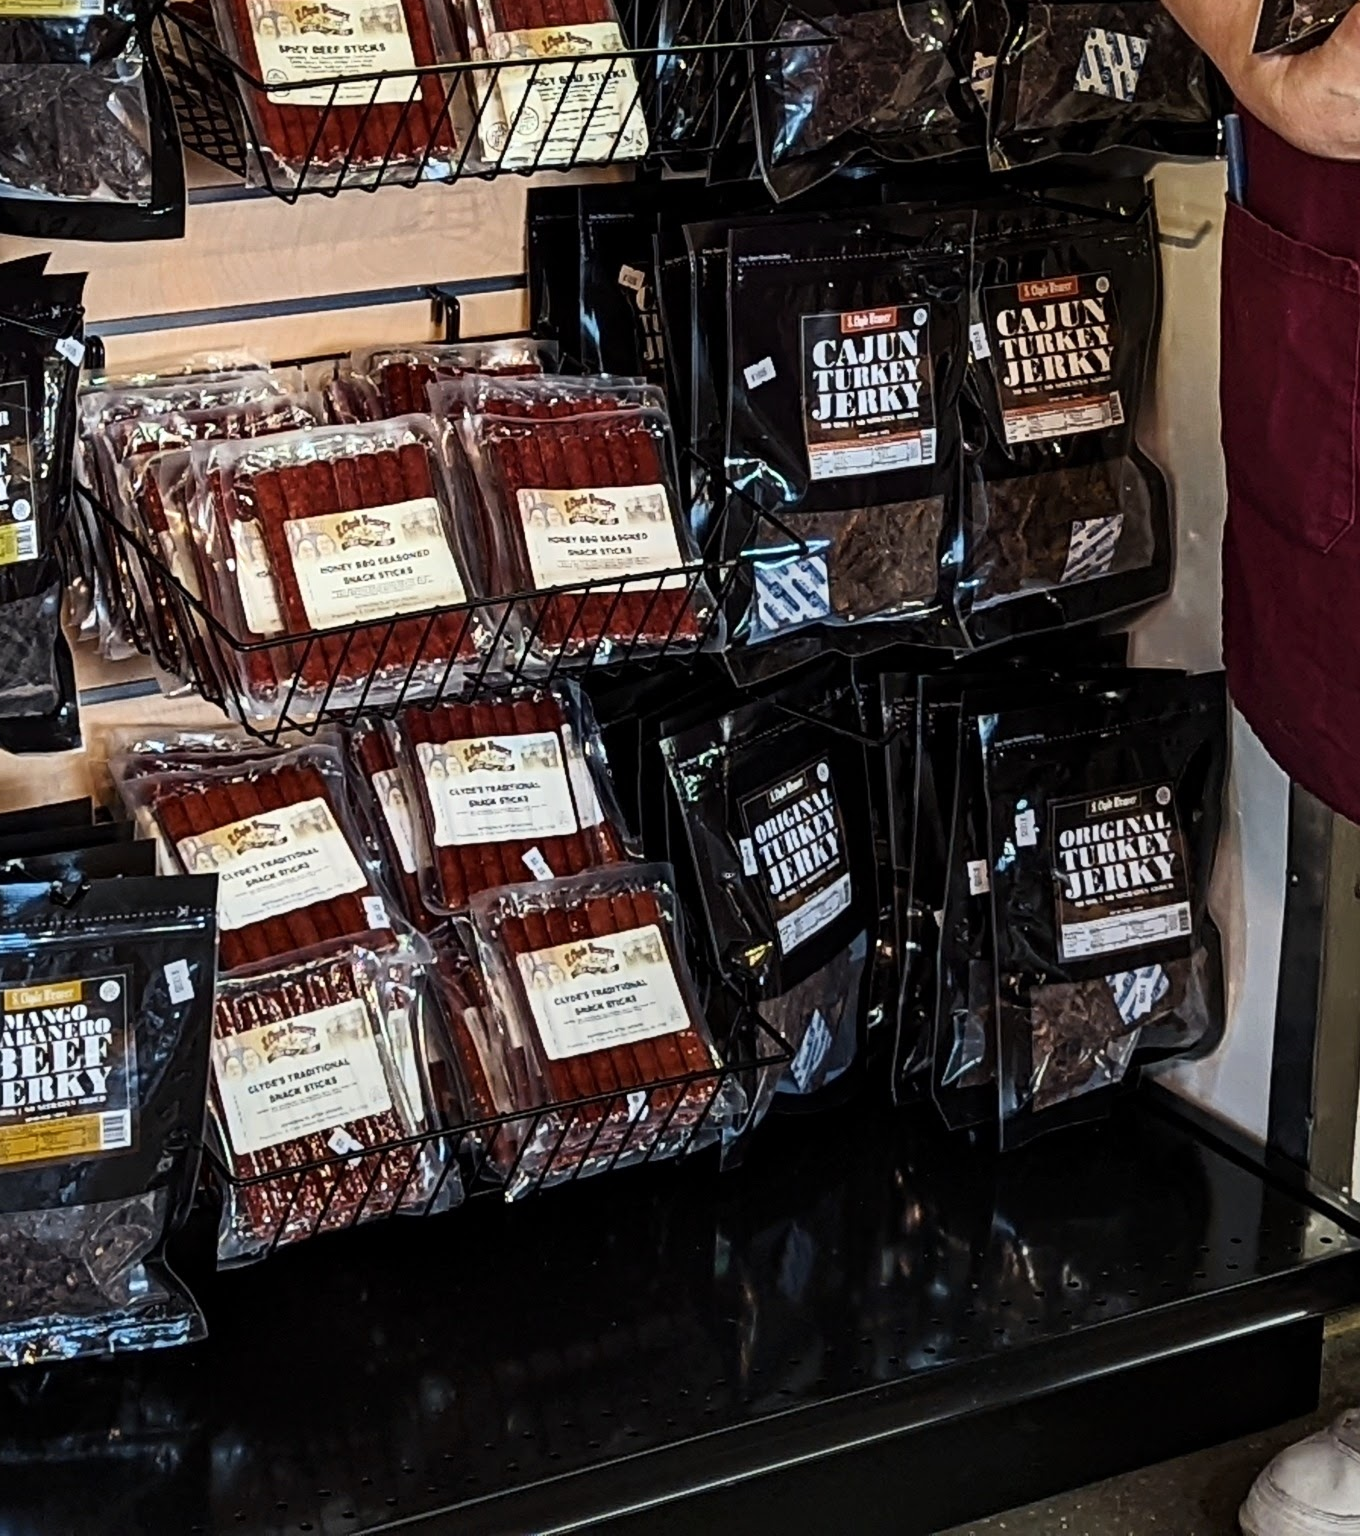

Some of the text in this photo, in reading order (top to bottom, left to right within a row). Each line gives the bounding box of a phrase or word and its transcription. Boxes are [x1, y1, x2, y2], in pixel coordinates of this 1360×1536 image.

[312, 45, 340, 54] BEEF
[996, 297, 1105, 336] CAJUN
[812, 329, 920, 368] CAJUN
[998, 325, 1110, 361] TURKEY
[812, 357, 921, 393] TURKEY
[1003, 346, 1115, 387] JERKY
[811, 381, 922, 421] JERKY
[320, 562, 353, 575] HONEY
[378, 549, 430, 565] SEASONED
[343, 566, 414, 584] SNACK STICKS
[754, 788, 834, 844] ORIGINAL
[1059, 811, 1171, 848] ORIGINAL
[758, 805, 836, 865] TURKEY
[1059, 829, 1172, 871] TURKEY
[222, 848, 319, 882] CLYDE'S TRADITIONAL
[245, 862, 310, 888] SNACK STICKS
[770, 828, 839, 895] JERKY
[1065, 853, 1176, 899] JERKY
[591, 979, 648, 996] TRADITIONAL
[607, 995, 638, 1008] STICKS
[3, 1004, 88, 1032] MANGO
[248, 1058, 351, 1095] CLYDE'S TRADITIONAL
[269, 1076, 338, 1103] SNACK STICKS
